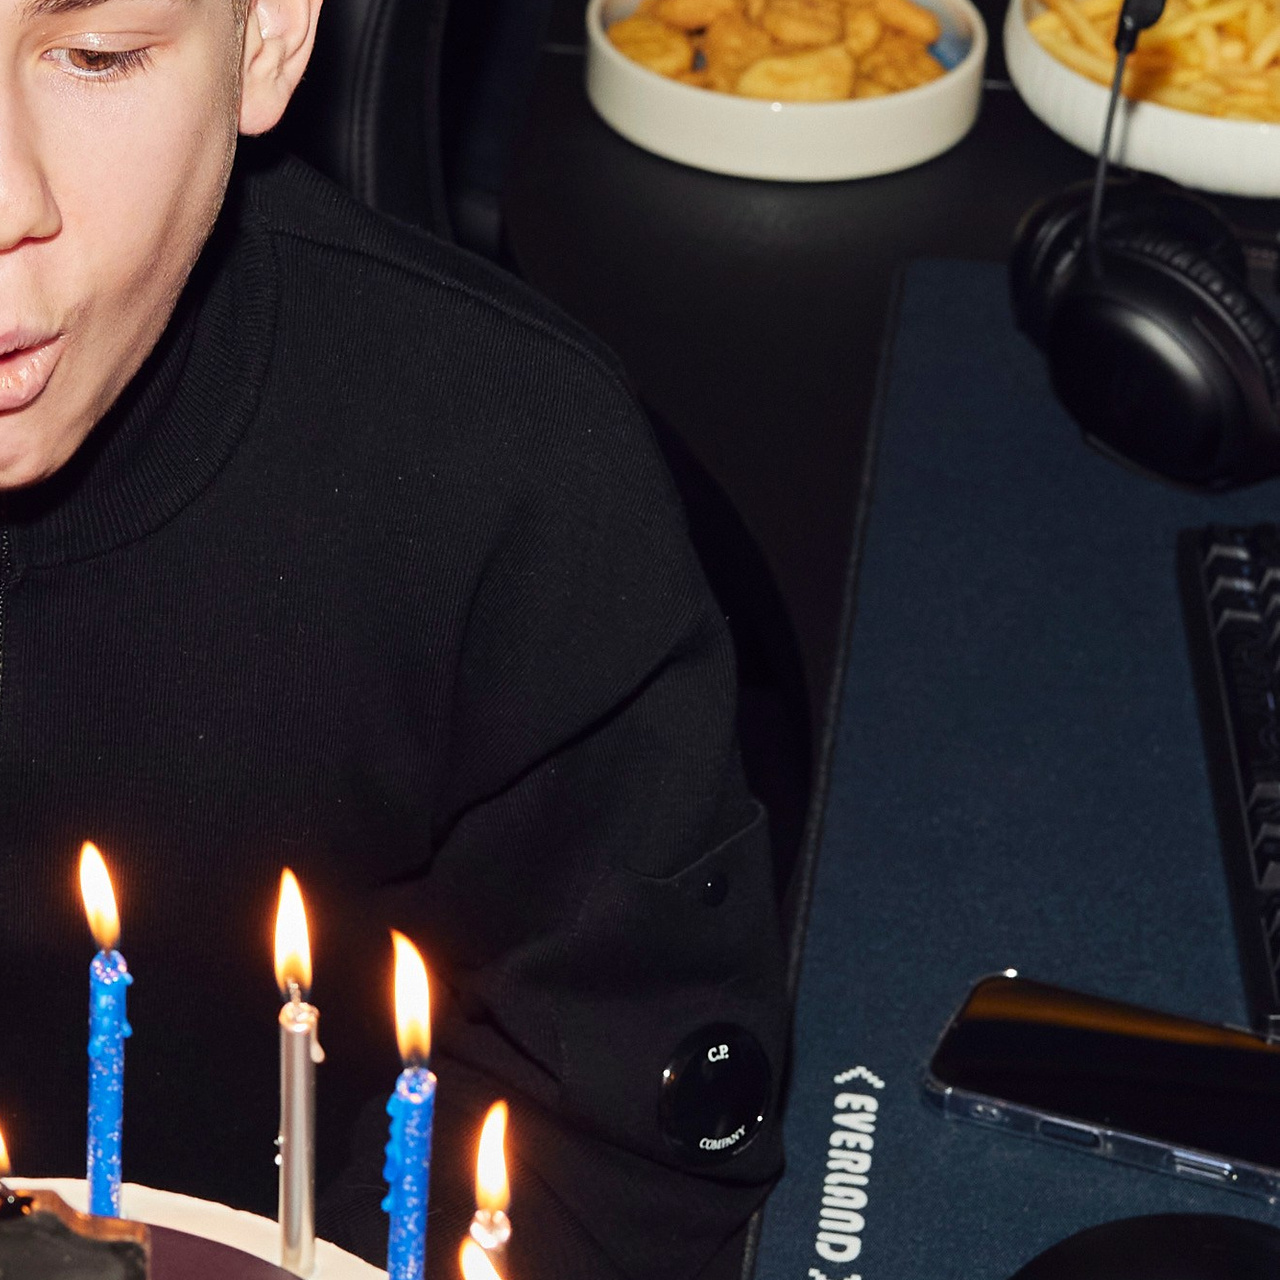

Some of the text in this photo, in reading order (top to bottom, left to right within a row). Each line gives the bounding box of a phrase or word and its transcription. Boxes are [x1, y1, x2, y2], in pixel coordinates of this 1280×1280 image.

[707, 1044, 730, 1063] C.P.
[699, 1124, 746, 1152] COMPANY
[815, 1092, 879, 1263] EVERLAND
